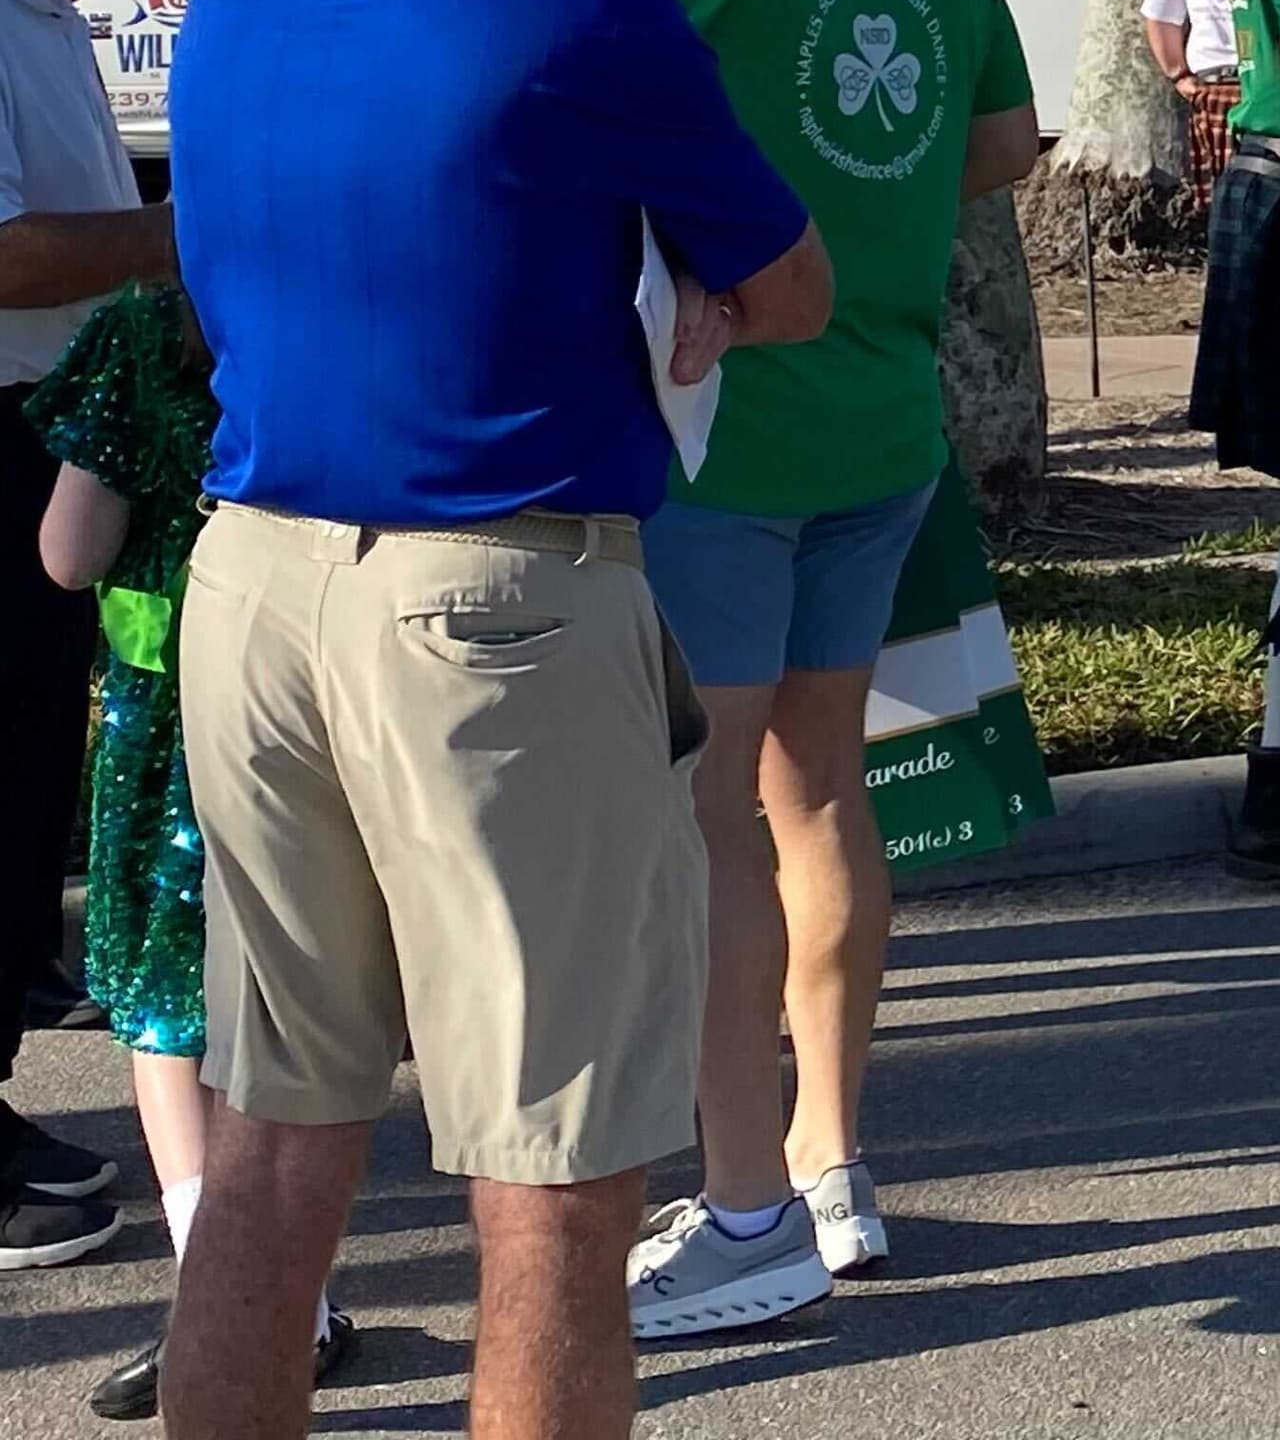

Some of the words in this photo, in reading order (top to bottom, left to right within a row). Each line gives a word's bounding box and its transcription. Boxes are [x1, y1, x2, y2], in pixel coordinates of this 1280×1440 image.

[796, 14, 824, 86] NAPLES
[926, 18, 947, 84] DANCE
[885, 826, 951, 861] 501(c)
[958, 821, 974, 841] 3
